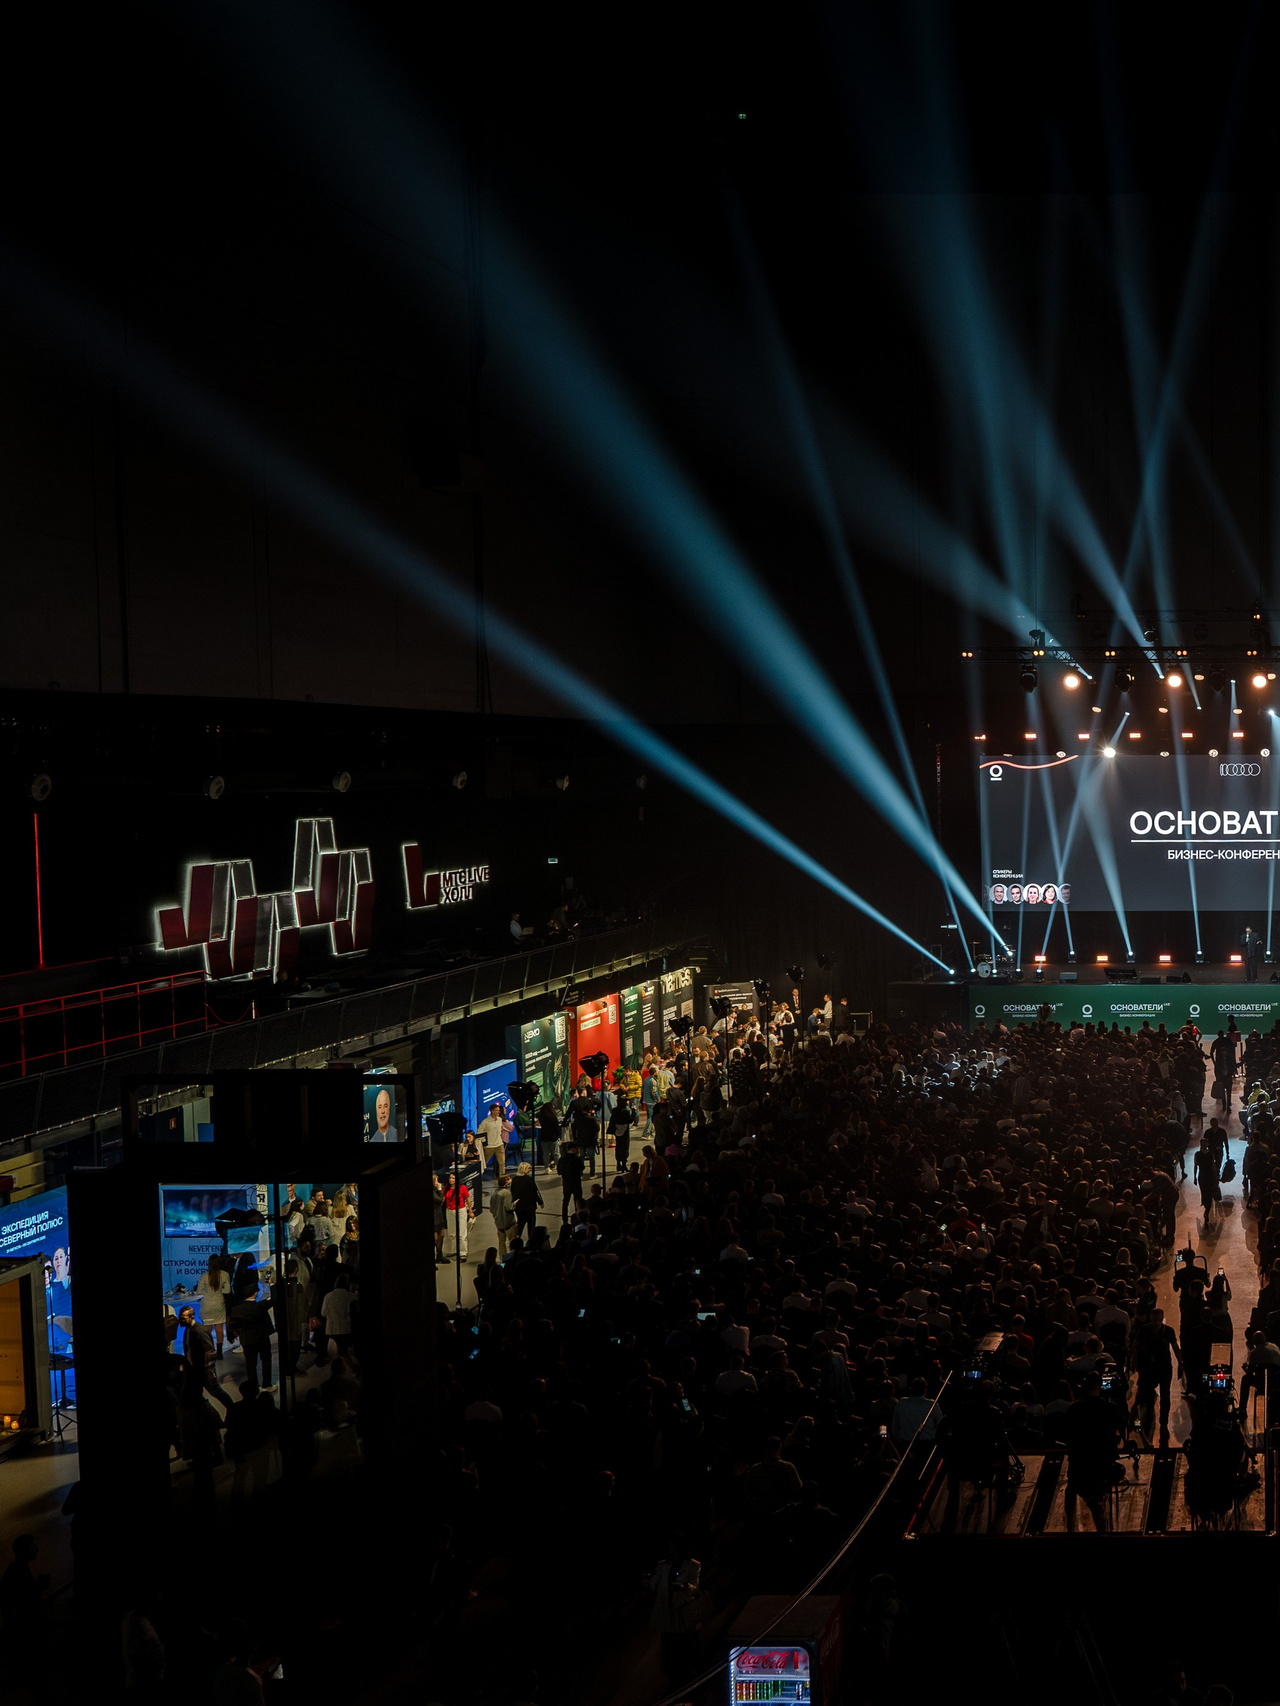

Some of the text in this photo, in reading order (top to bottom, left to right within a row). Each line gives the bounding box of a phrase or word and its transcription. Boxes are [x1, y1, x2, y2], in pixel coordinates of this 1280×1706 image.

[1217, 1003, 1271, 1011] ОСНОВАТЕЛИ
[1, 1210, 49, 1236] ЭКСПЕДИЦИЯ
[37, 1216, 63, 1234] ПОЛЮС
[163, 1258, 196, 1268] ОТКРОЙ
